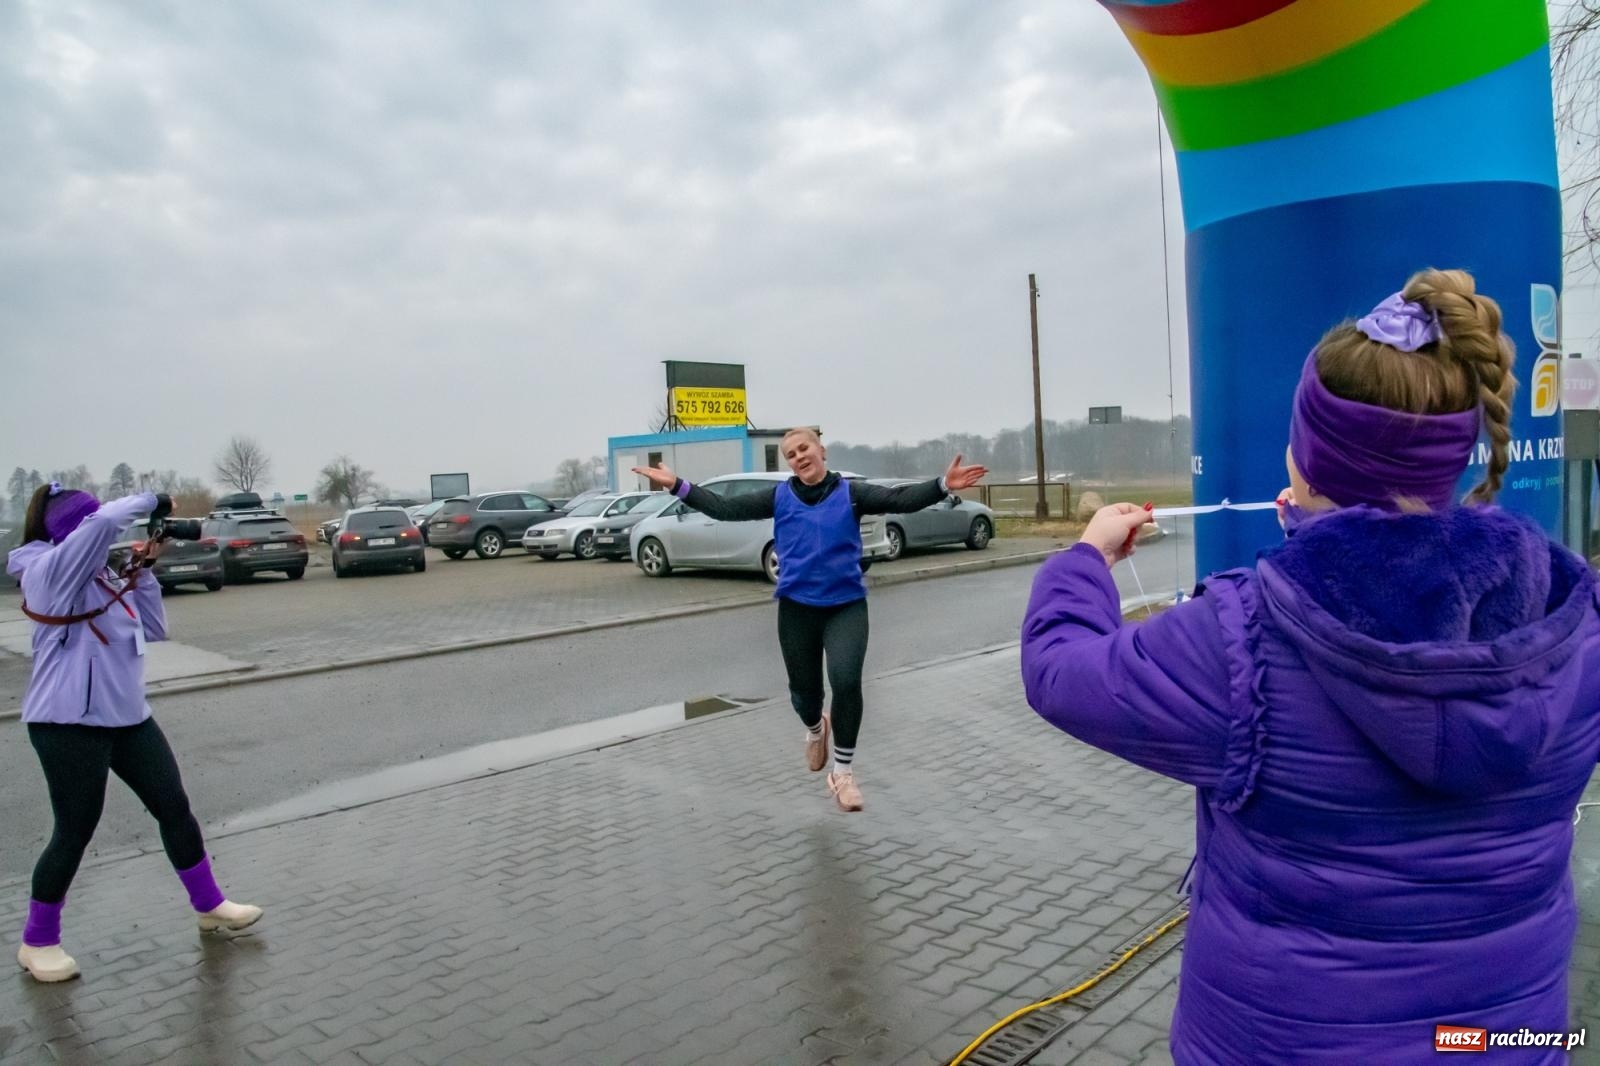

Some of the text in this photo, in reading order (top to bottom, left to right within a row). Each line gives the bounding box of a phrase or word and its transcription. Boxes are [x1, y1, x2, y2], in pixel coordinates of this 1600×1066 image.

[1564, 378, 1596, 390] STOP
[677, 401, 745, 413] 575 792 626
[1468, 437, 1564, 466] MNA KRZY
[1512, 477, 1541, 491] odkryj
